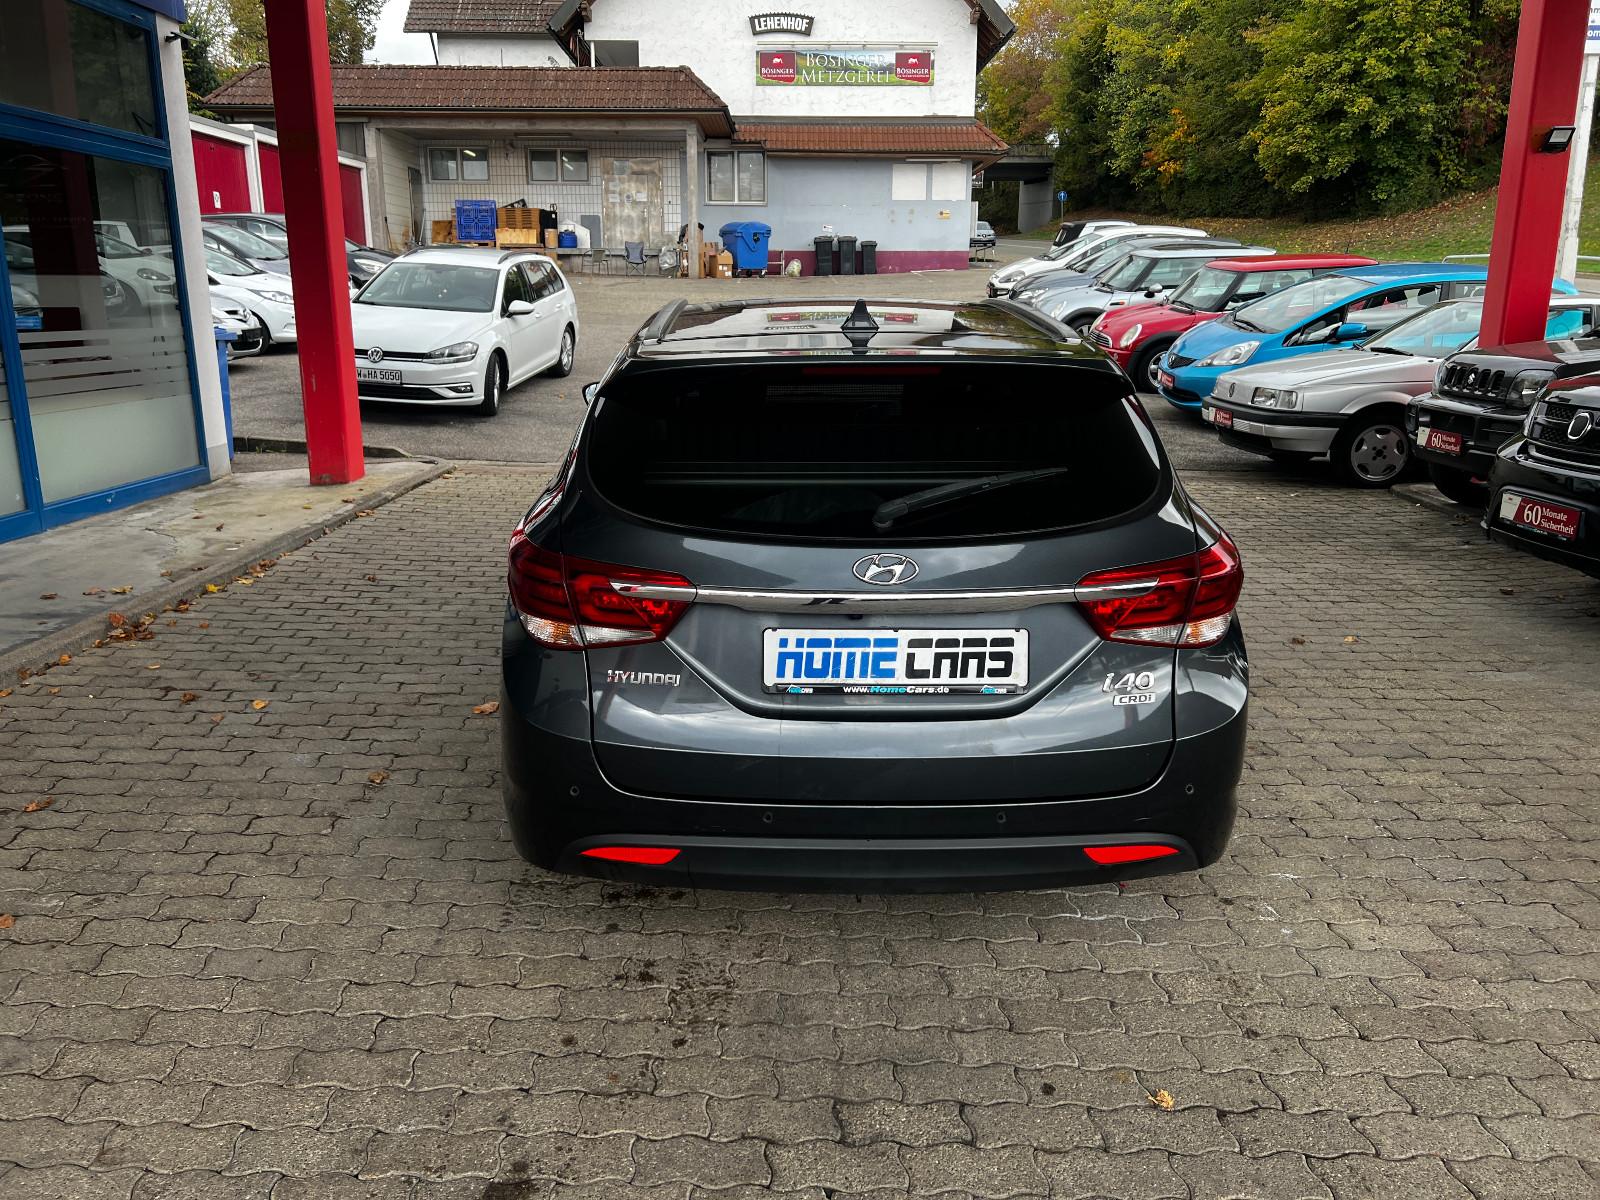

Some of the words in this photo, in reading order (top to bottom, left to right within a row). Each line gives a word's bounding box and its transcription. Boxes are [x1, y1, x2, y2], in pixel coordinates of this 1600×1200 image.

[754, 15, 810, 32] LEHENHOF
[801, 69, 889, 83] METZGEREI
[367, 370, 378, 379] HA
[379, 371, 400, 381] 5050
[1431, 432, 1442, 448] 60
[1524, 504, 1541, 525] 60
[1542, 507, 1567, 520] Monate
[775, 637, 899, 679] HOME
[905, 637, 1015, 679] CARS
[606, 669, 681, 687] HYUNDAI
[1102, 671, 1156, 693] i40
[843, 685, 950, 695] www.HomeCars.de
[1119, 694, 1152, 704] CRDi
